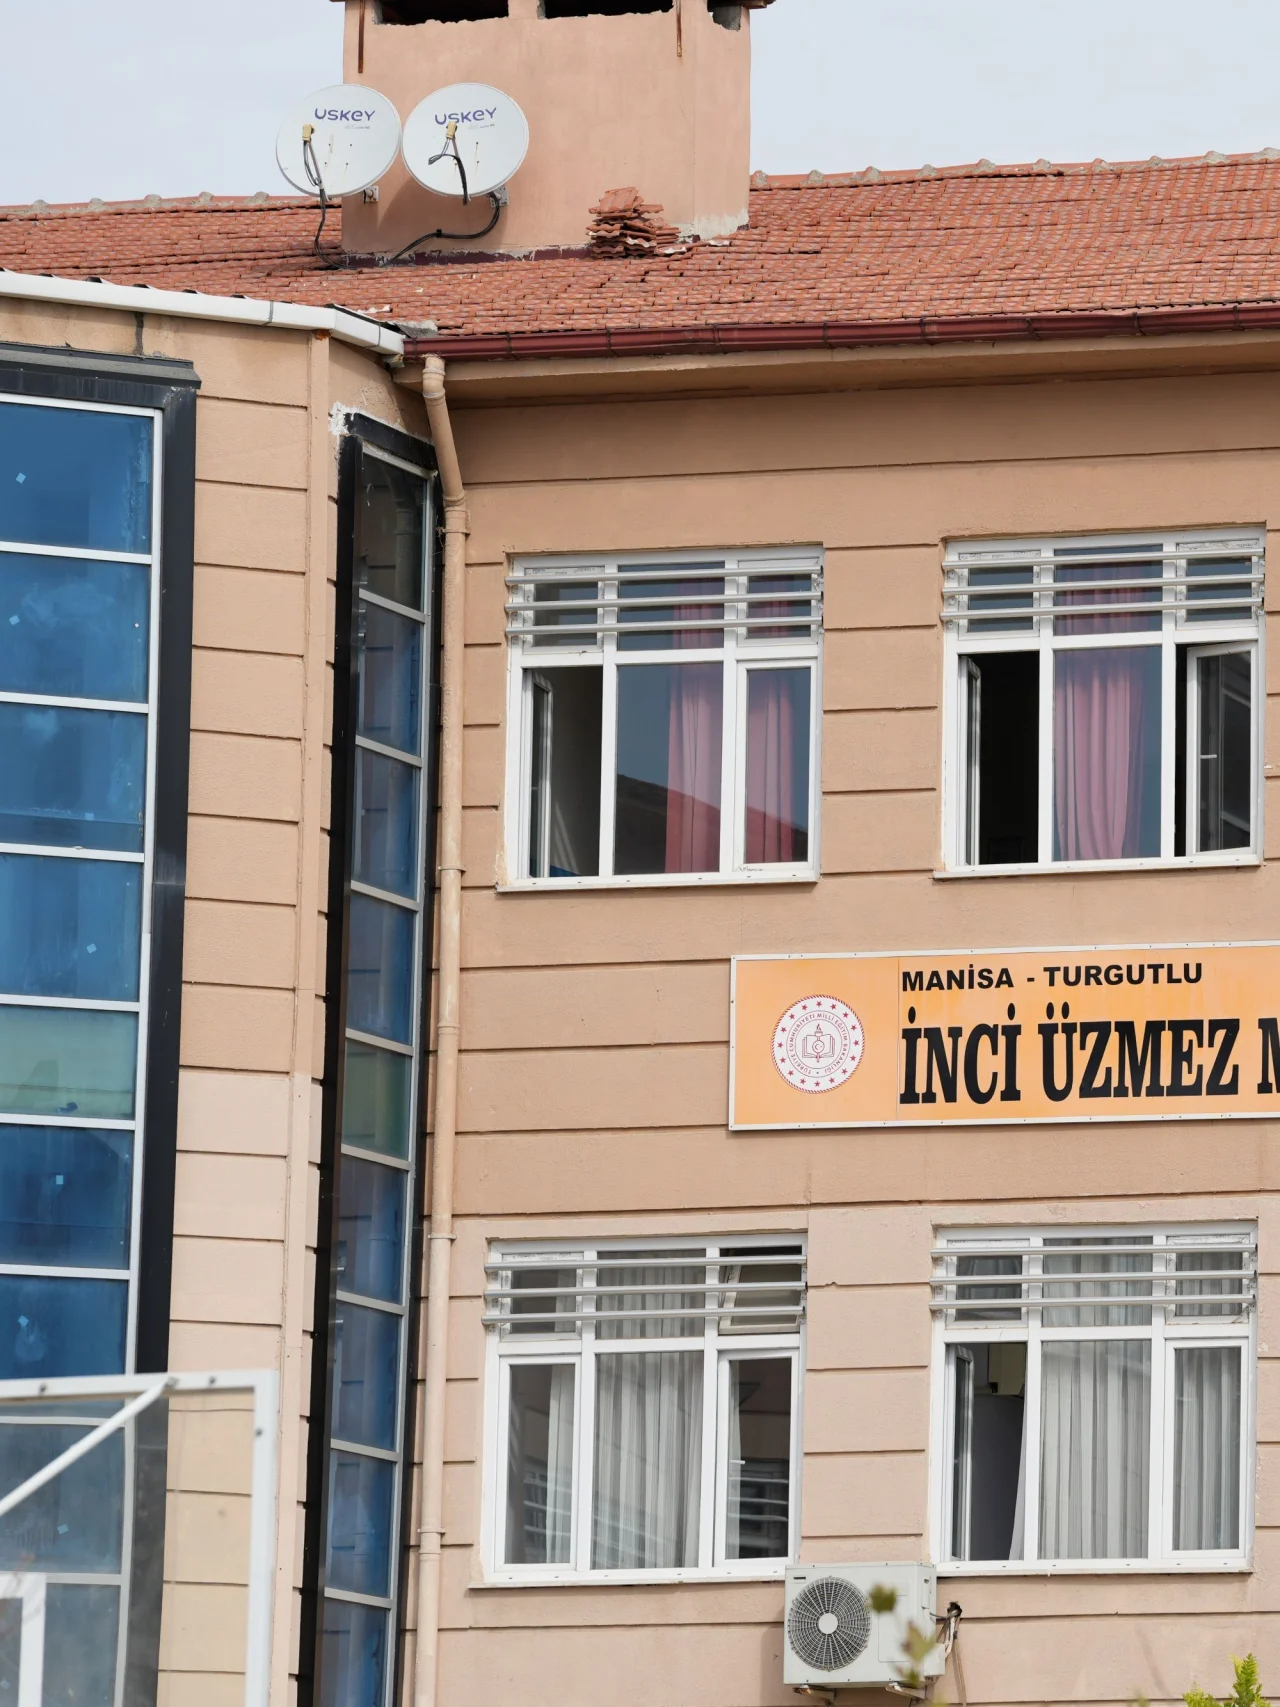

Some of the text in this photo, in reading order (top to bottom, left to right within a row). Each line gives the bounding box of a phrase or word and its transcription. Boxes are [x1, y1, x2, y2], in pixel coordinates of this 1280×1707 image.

[902, 963, 1015, 992] MANİSA
[1043, 962, 1202, 987] TURGUTLU
[900, 1003, 1021, 1105] İNCİ
[1038, 1001, 1239, 1102] ÜZMEZ
